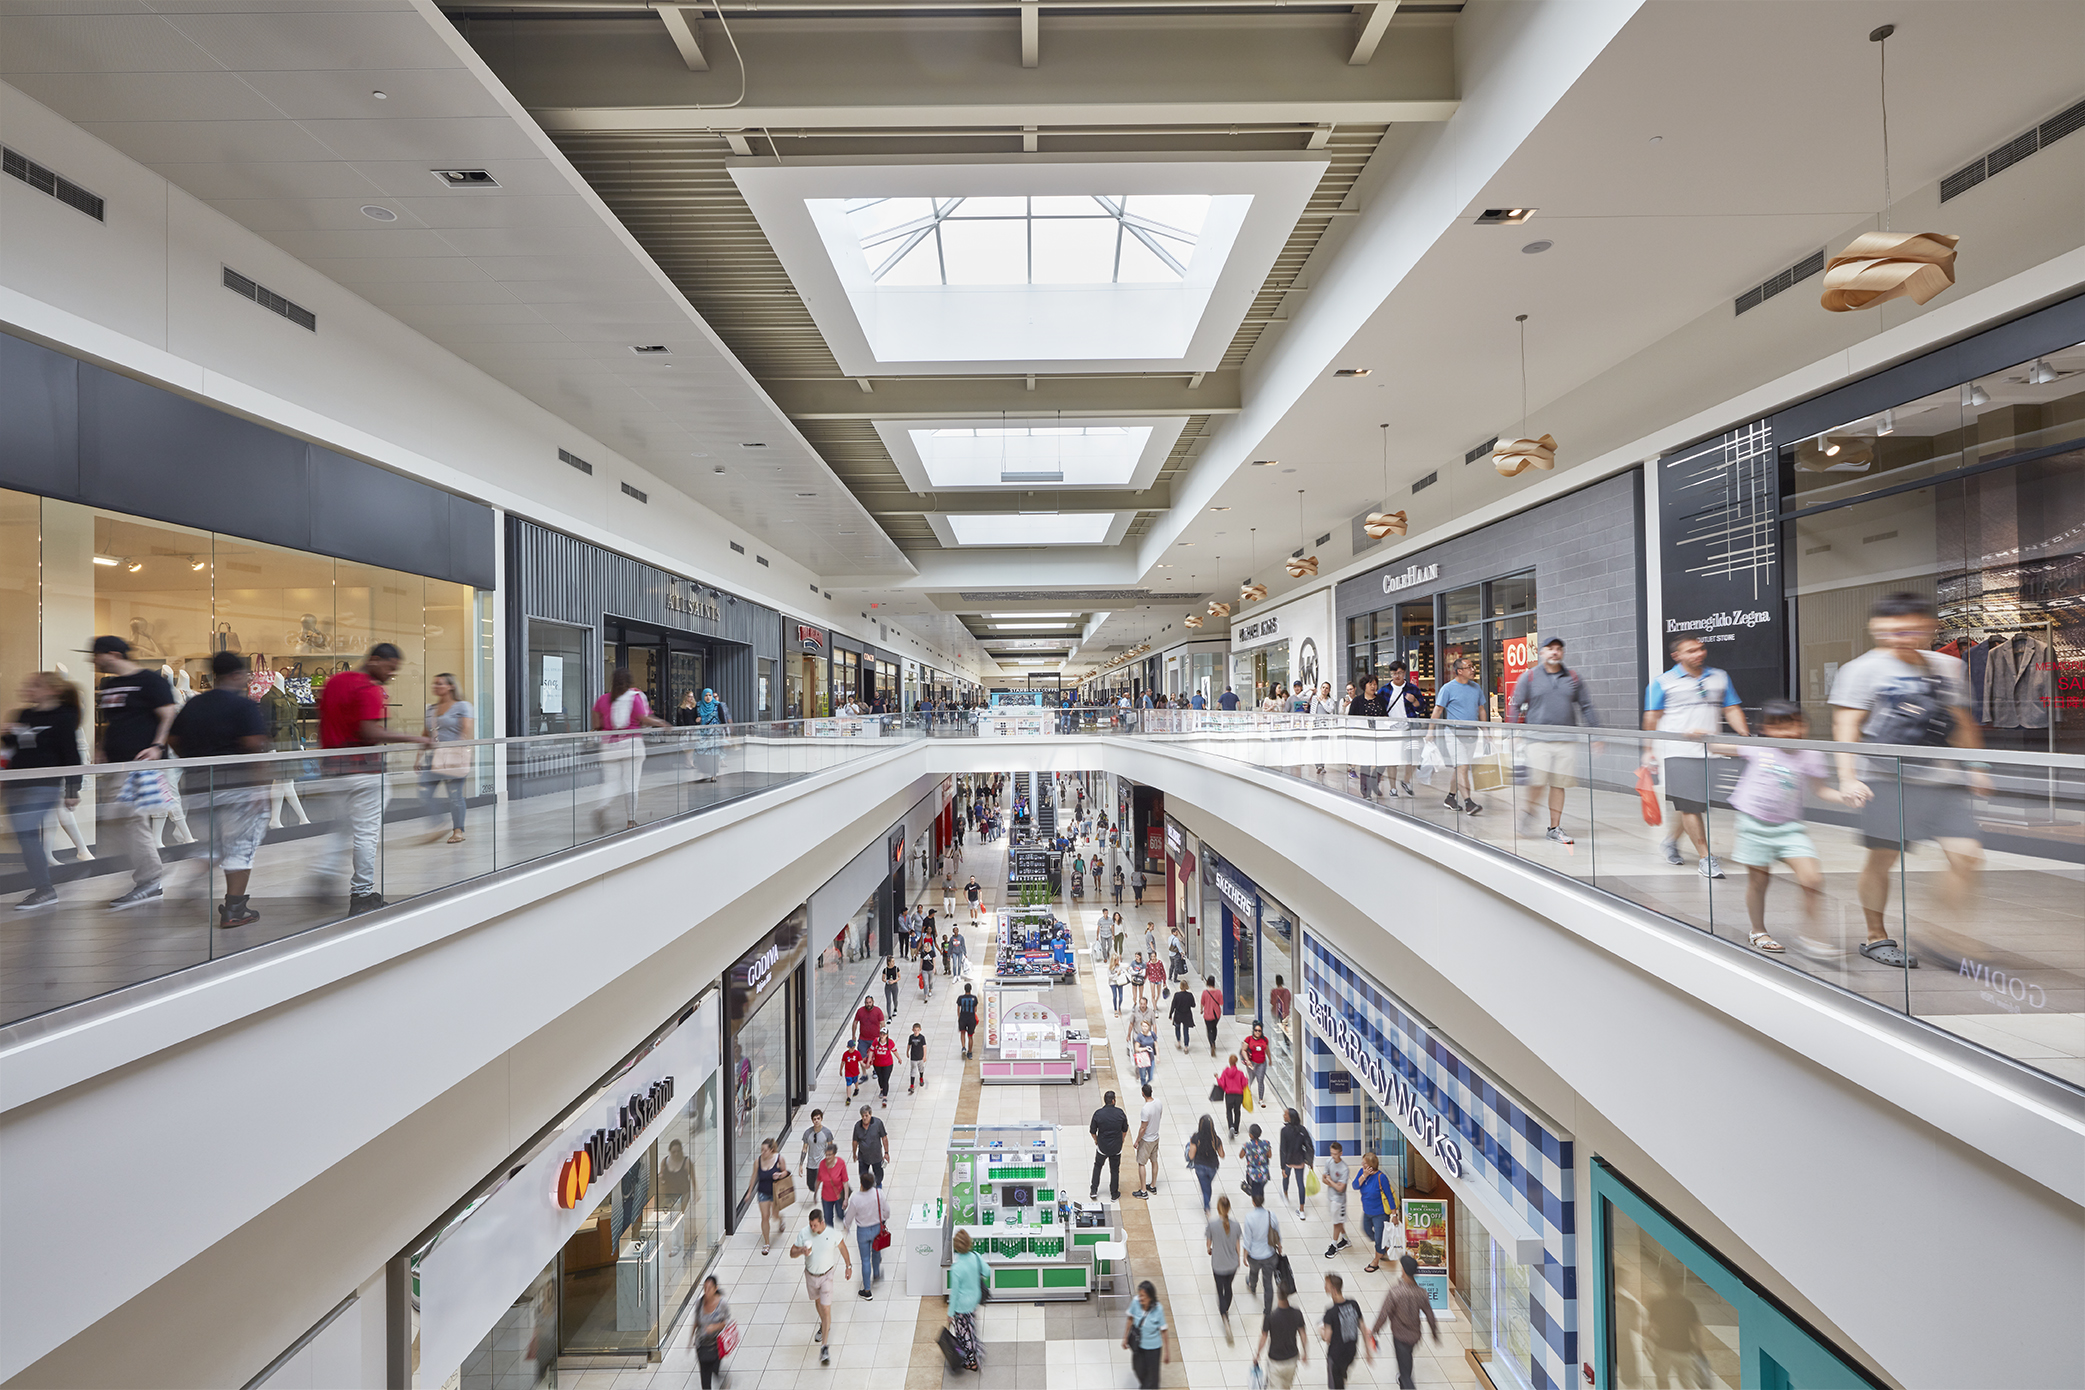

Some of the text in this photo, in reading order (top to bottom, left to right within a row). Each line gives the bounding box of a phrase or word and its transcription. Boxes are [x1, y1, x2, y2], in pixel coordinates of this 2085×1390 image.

[1666, 610, 1771, 632] Ermenegildo Zegna
[1717, 634, 1736, 642] STORE
[2035, 661, 2085, 671] MEMORI
[1215, 872, 1252, 917] SKECHERS
[747, 944, 779, 987] GODIVA
[584, 1075, 675, 1184] Watch Station
[1407, 1213, 1431, 1228] $10
